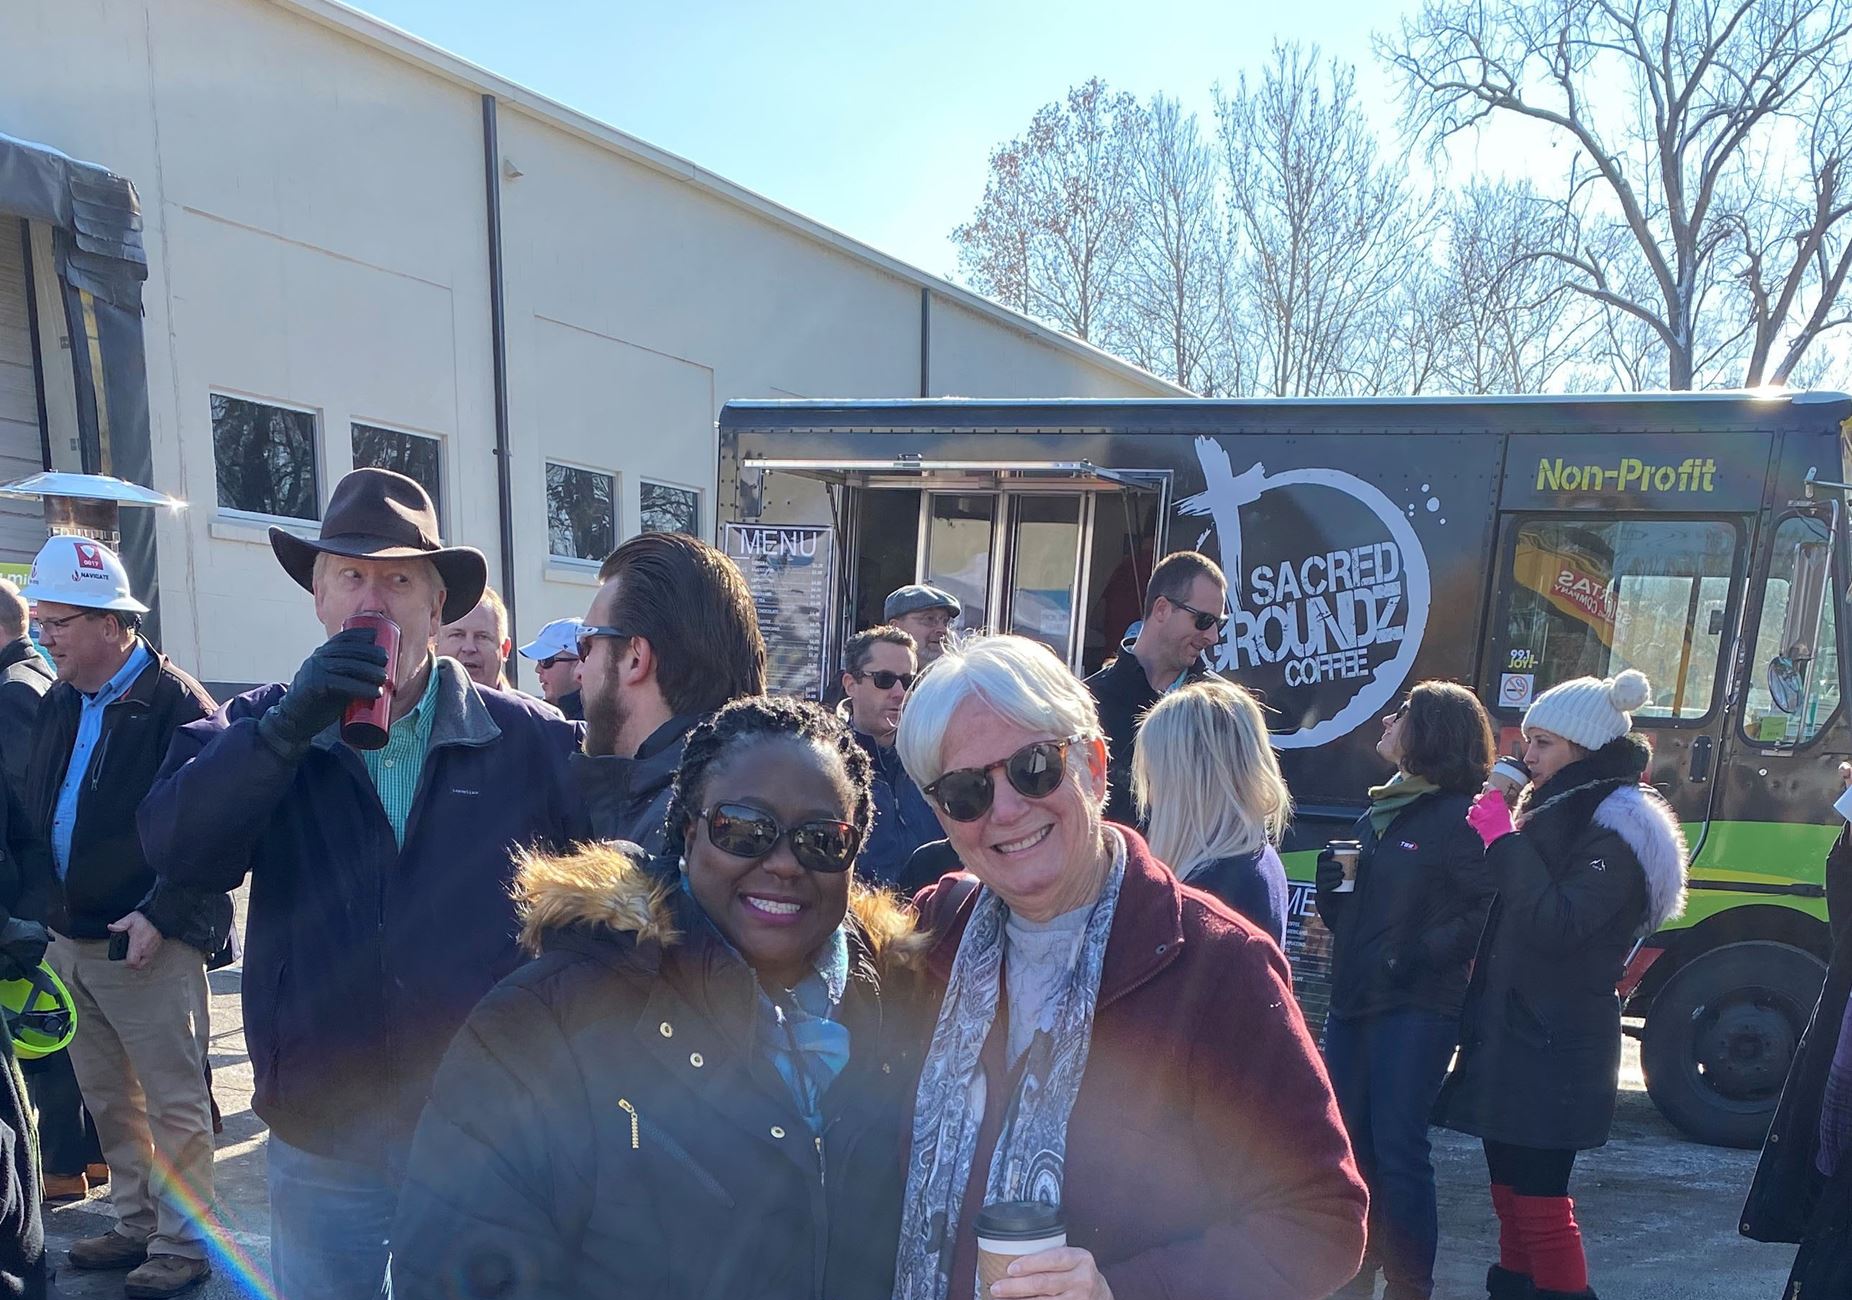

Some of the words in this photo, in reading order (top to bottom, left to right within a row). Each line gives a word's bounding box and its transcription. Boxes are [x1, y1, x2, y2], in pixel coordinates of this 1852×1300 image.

[1536, 458, 1716, 492] Non-Profit
[740, 529, 817, 557] MENU
[80, 572, 109, 581] NAVIGATE
[1251, 541, 1400, 605] SACRED
[1284, 648, 1369, 687] COFFEE
